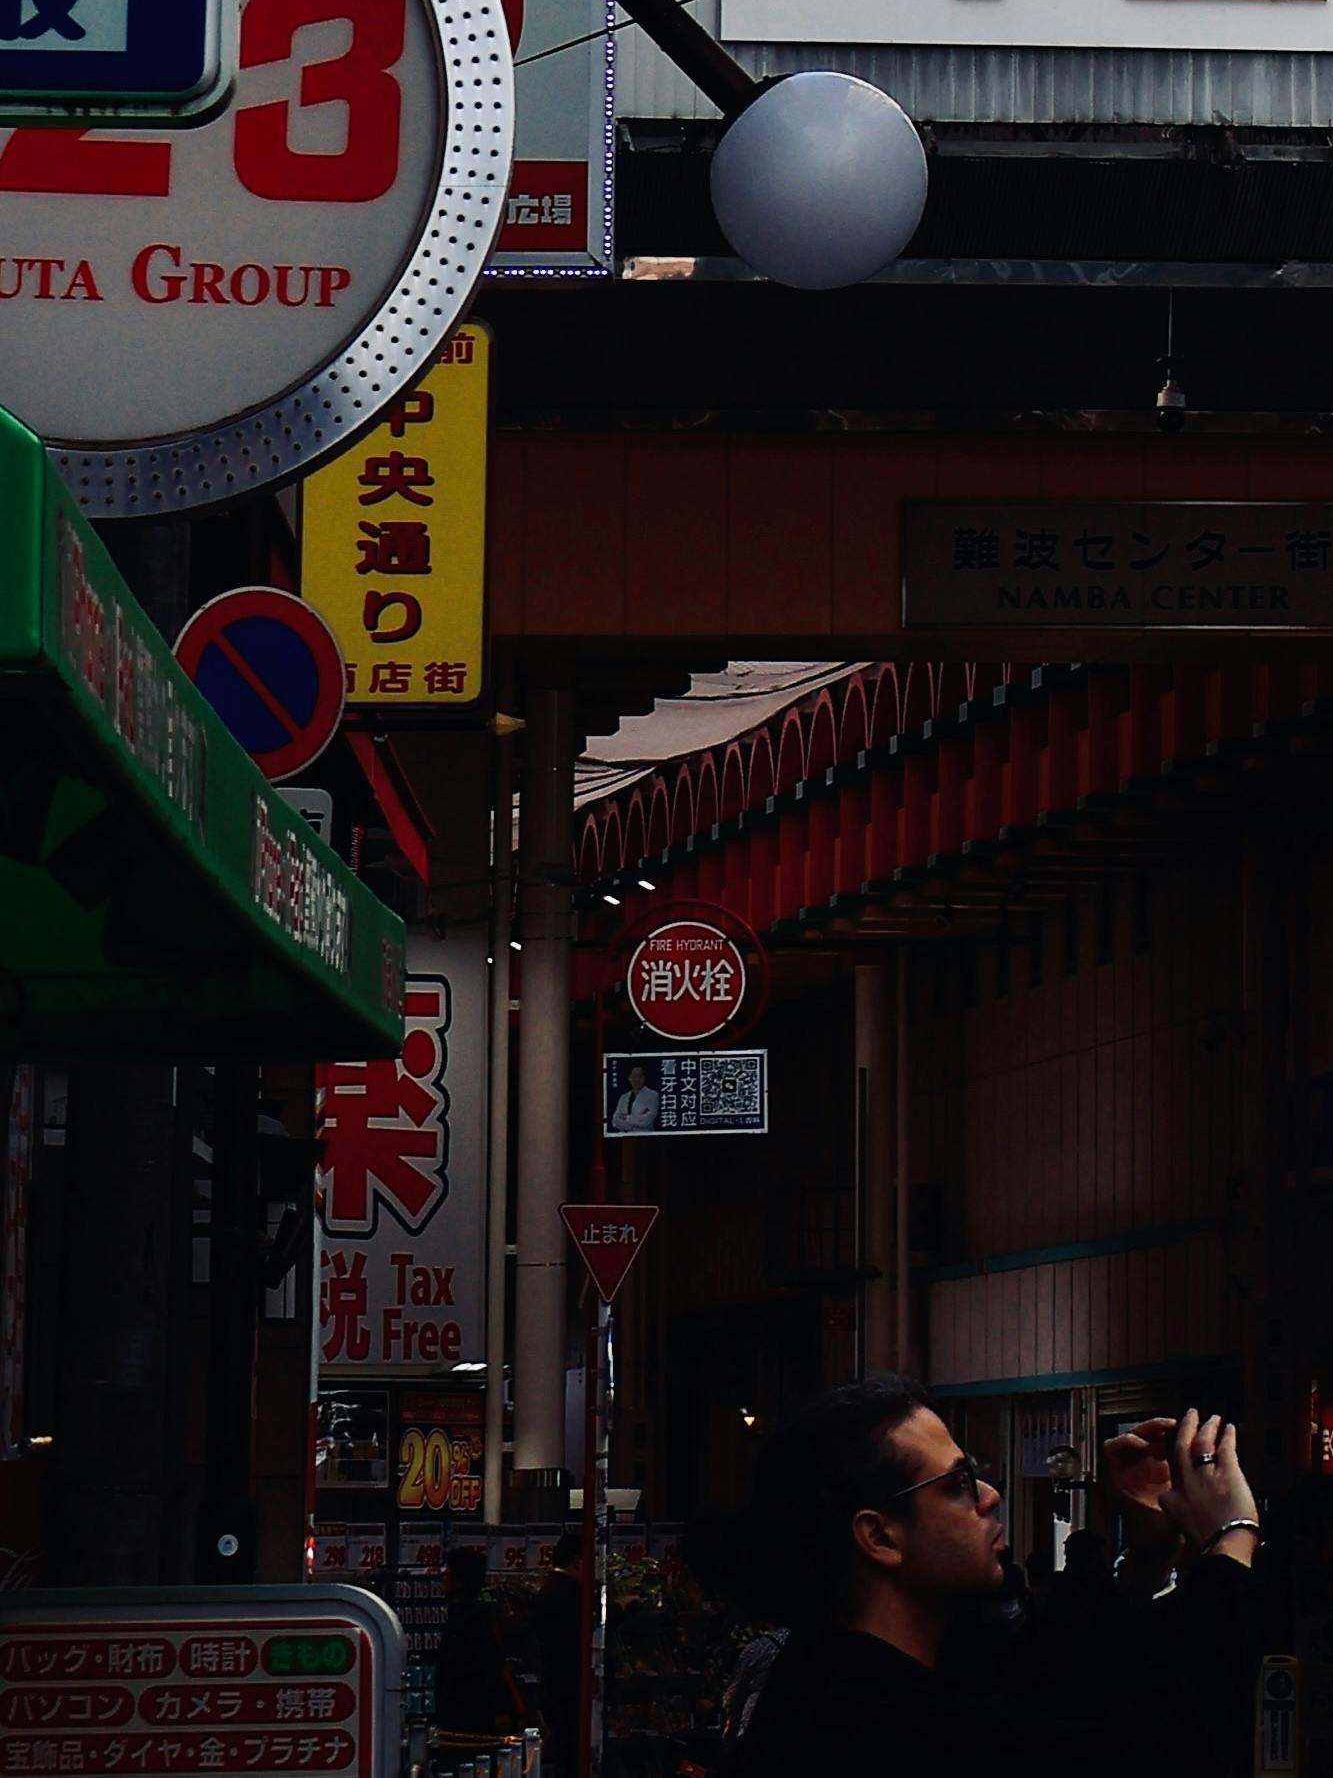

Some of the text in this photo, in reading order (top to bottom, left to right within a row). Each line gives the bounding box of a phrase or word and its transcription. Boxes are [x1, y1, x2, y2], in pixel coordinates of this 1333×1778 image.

[131, 243, 351, 308] GROUP
[355, 387, 434, 643] 中央通り
[952, 528, 1333, 571] 難波センター街
[998, 585, 1290, 609] NAMBA CENTER
[649, 938, 725, 952] FIRE HYDRANT
[641, 958, 735, 1002] 消火栓
[660, 1059, 678, 1128] 看牙扫我
[680, 1058, 698, 1127] 中文对应
[581, 1224, 639, 1247] 止まれ
[390, 1254, 455, 1307] Tax
[382, 1308, 462, 1360] Free
[448, 1475, 482, 1511] OFF
[190, 1642, 252, 1673] 時計
[6, 1693, 125, 1723] パソコン
[155, 1687, 337, 1721] カメラ・携帯
